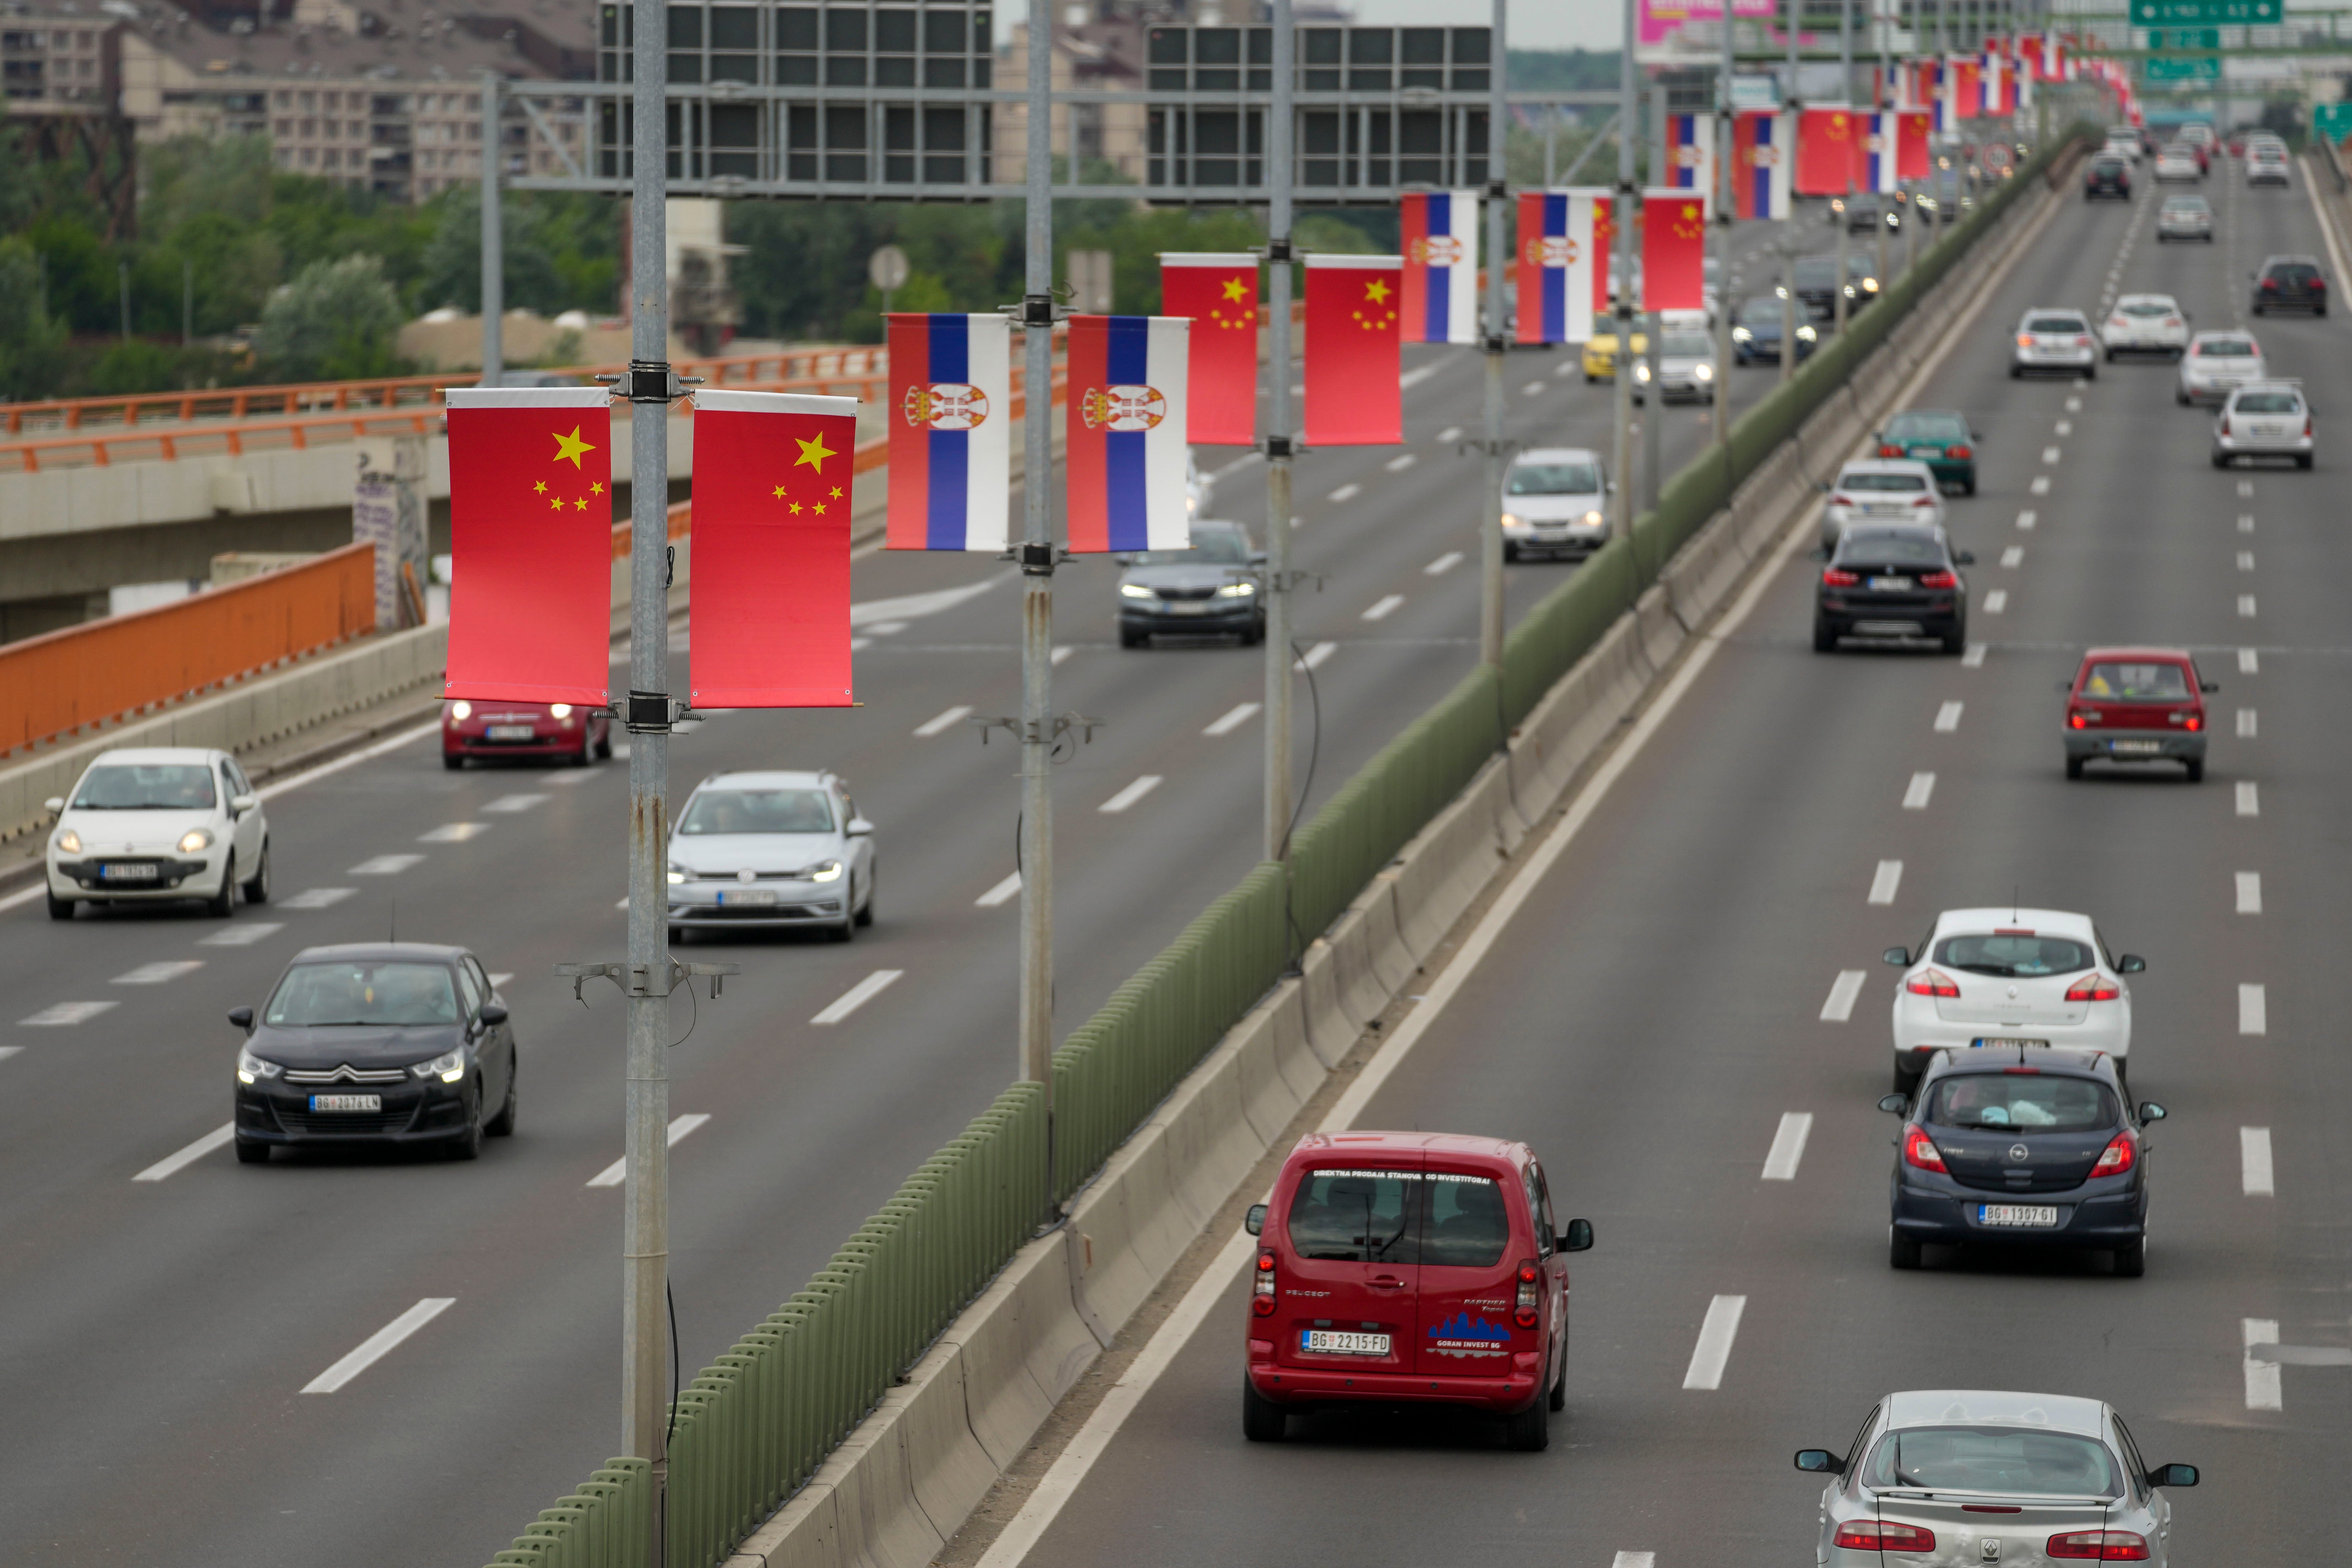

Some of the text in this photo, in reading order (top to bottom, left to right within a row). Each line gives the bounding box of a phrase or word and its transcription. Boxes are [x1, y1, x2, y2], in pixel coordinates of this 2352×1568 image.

[317, 1098, 328, 1108] BG
[1988, 1207, 2001, 1219] BG
[1312, 1333, 1326, 1346] BG
